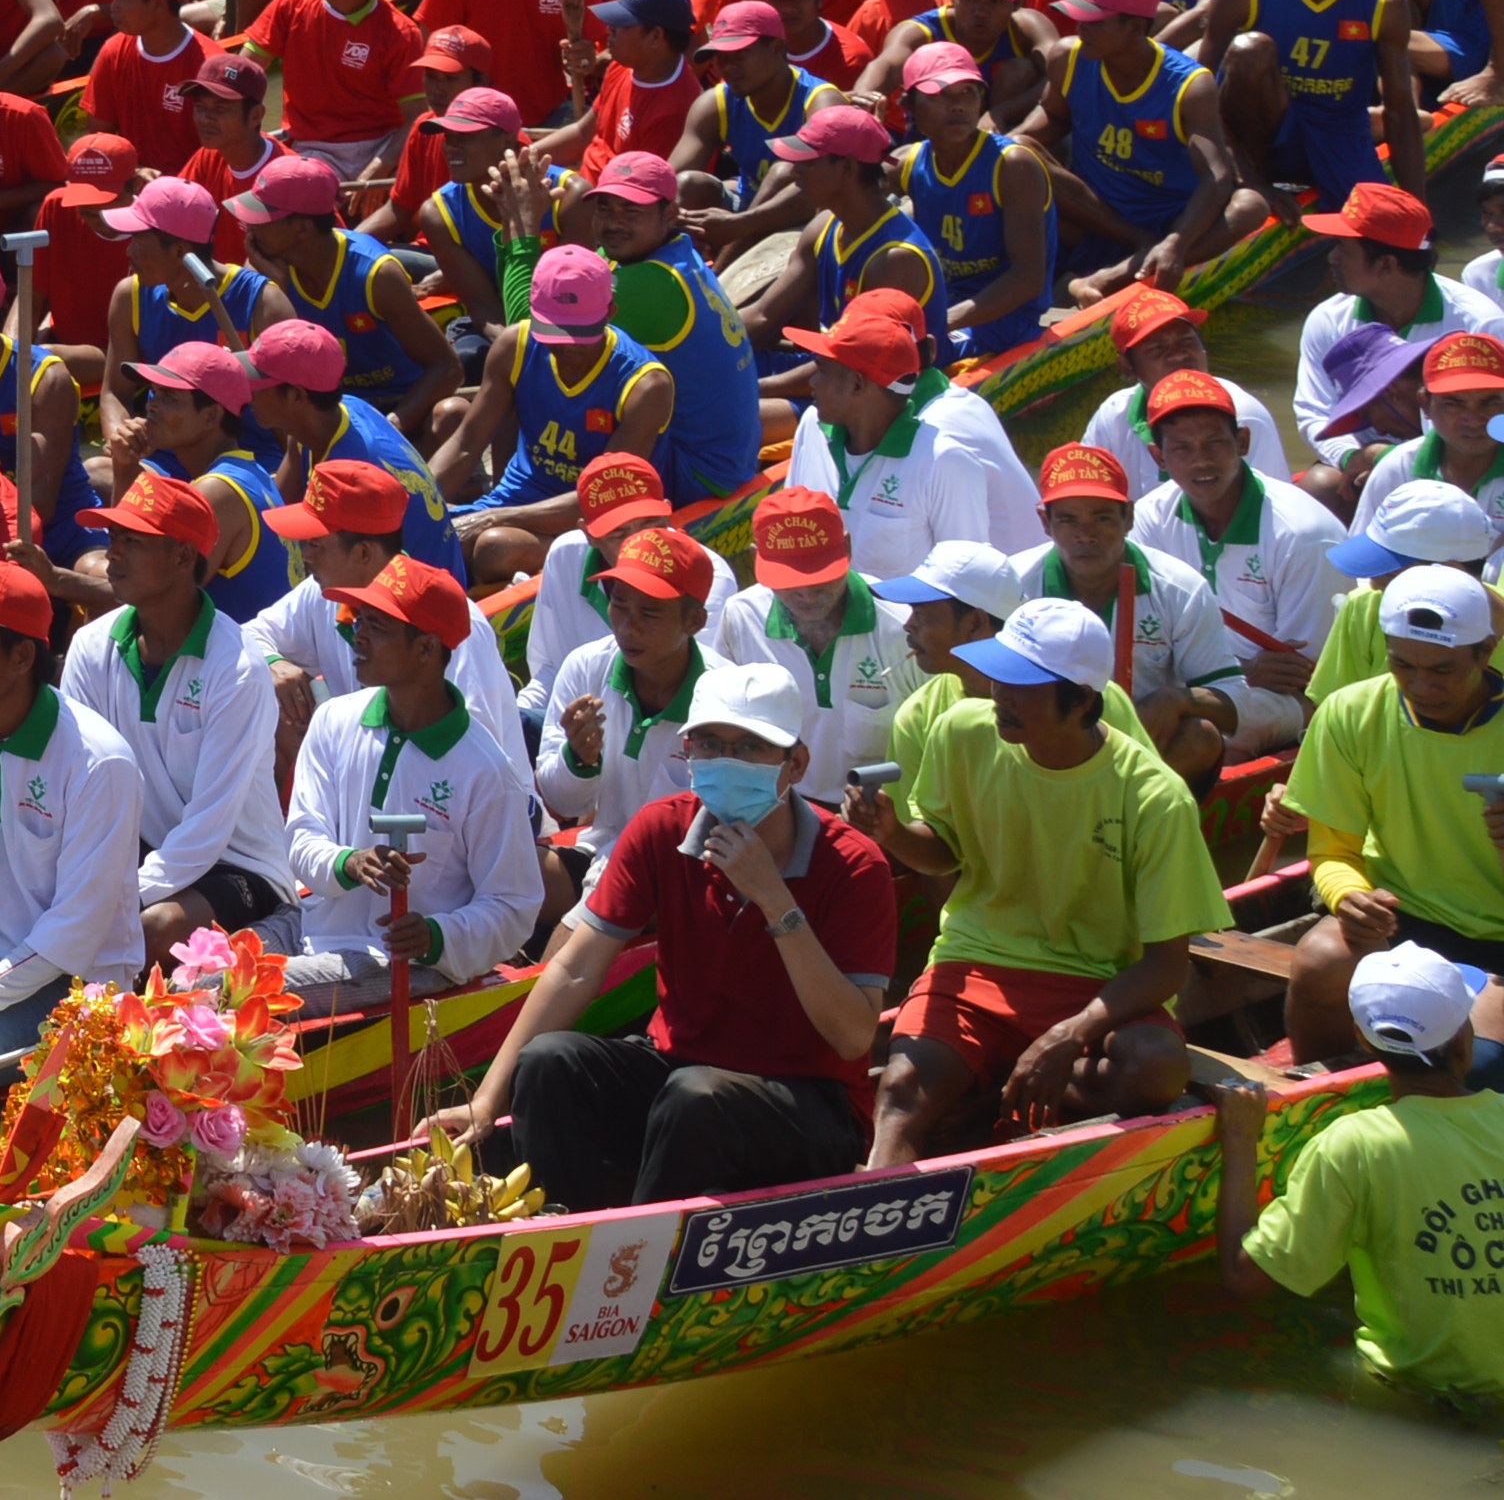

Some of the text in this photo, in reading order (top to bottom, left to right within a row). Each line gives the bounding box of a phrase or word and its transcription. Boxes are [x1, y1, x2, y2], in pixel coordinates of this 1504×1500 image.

[1290, 37, 1331, 69] 47
[1098, 123, 1133, 159] 48
[1436, 341, 1457, 370] CHÙA
[1458, 335, 1491, 355] CHAM
[1448, 353, 1489, 367] PHÚ TÂN
[1153, 378, 1172, 409] CHÙA
[1172, 372, 1206, 389] CHAM
[1163, 386, 1206, 403] PHÚ TÂN
[538, 420, 577, 461] 44
[1047, 458, 1067, 488] CHÙA
[1066, 450, 1103, 469] CHAM
[1057, 465, 1100, 483] PHÚ TÂN
[589, 478, 604, 508] CHÙA
[602, 468, 635, 484] CHAM
[598, 485, 637, 504] PHÚ TÂN
[765, 521, 785, 549] CHÙA
[784, 516, 818, 533] CHAM
[776, 534, 818, 549] PHÚ TÂN
[1414, 1198, 1457, 1254] ĐỘI
[1450, 1233, 1477, 1270] Ô
[475, 1237, 581, 1364] 35
[1424, 1272, 1502, 1300] THỊ XÃ
[596, 1304, 620, 1320] BIA
[564, 1315, 636, 1345] SAIGON
